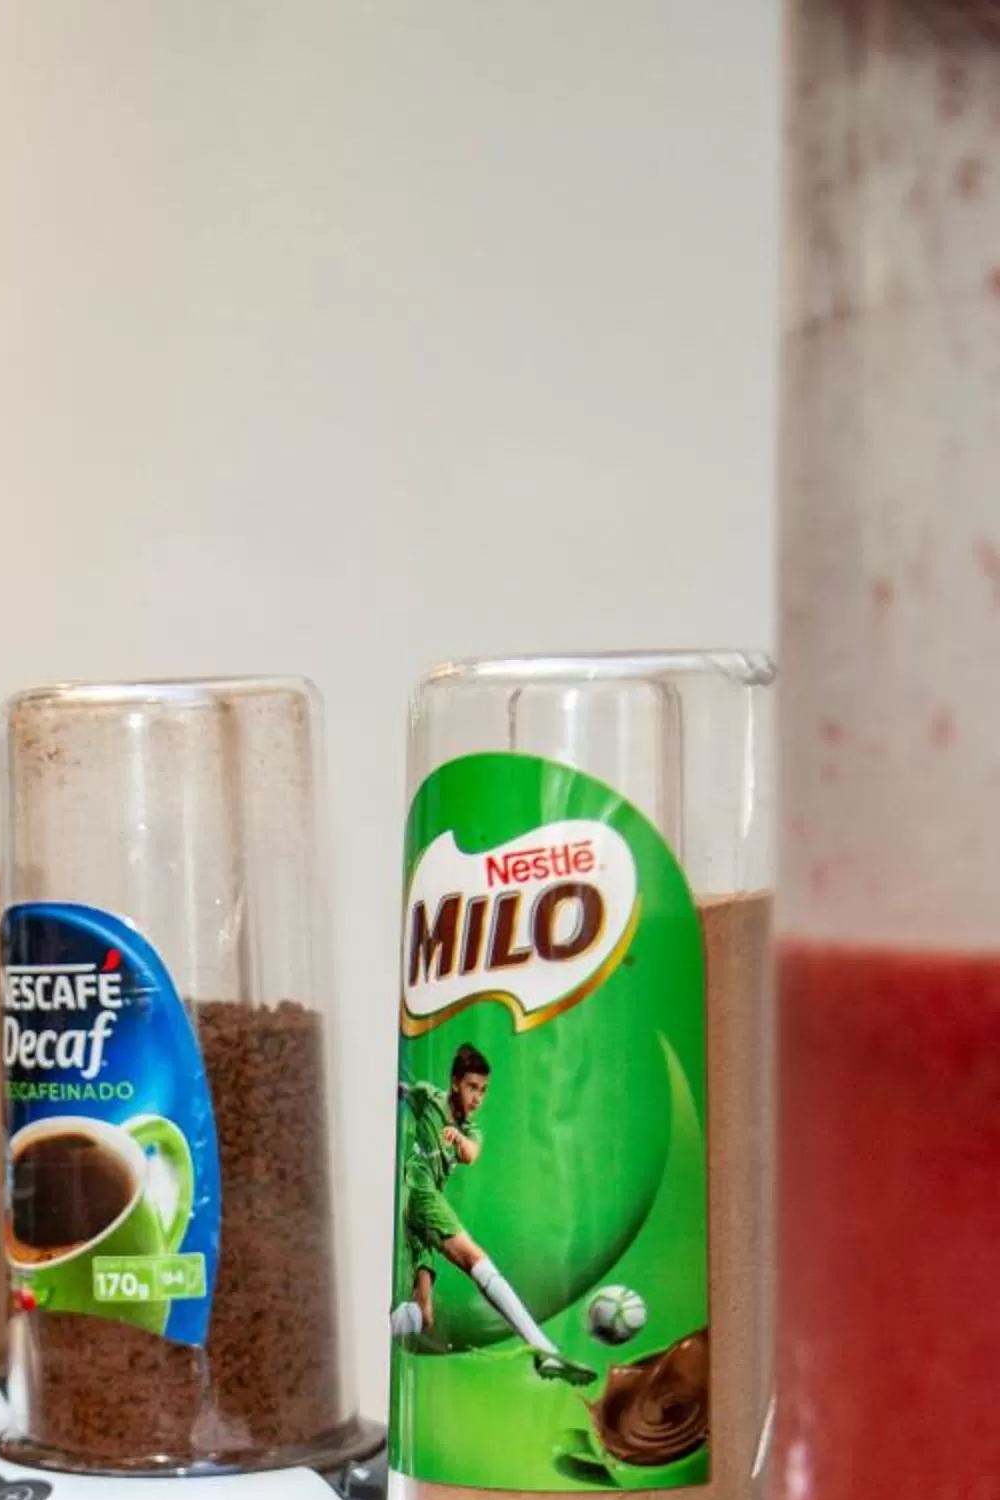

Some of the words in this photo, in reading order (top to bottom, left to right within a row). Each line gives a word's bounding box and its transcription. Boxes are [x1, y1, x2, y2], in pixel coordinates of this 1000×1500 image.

[486, 840, 596, 888] Nestlé
[407, 880, 607, 987] MILO
[3, 1010, 117, 1080] Decaf
